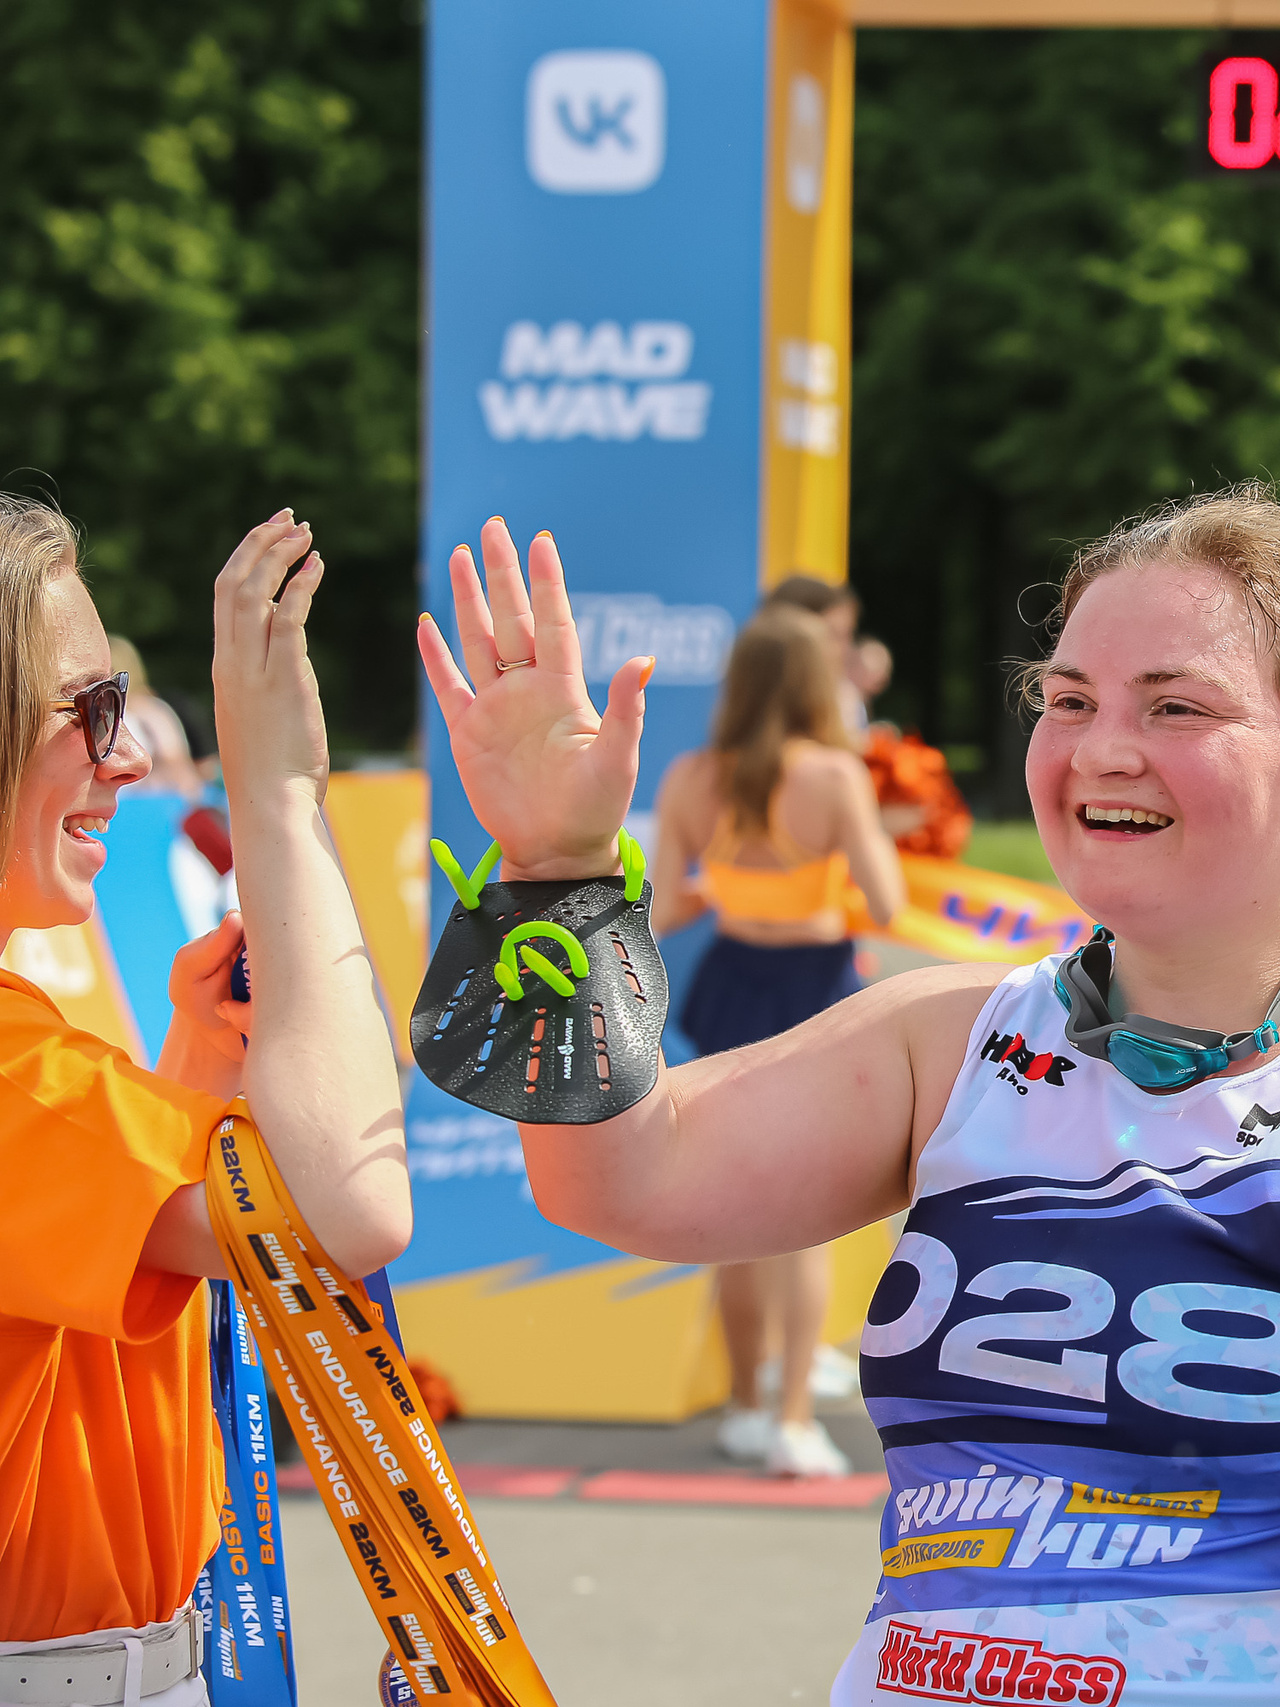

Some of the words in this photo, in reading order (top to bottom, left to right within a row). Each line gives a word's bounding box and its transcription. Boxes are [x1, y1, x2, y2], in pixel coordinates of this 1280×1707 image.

[556, 95, 636, 152] VK
[502, 320, 694, 380] MAD
[479, 380, 713, 442] WAVE
[563, 1056, 572, 1080] MAD
[220, 1135, 256, 1213] 22KM
[365, 1345, 415, 1417] 22KM
[247, 1393, 266, 1464] 11KM
[305, 1330, 408, 1486] ENDURANCE
[398, 1488, 451, 1559] 22KM
[254, 1471, 276, 1565] BASIC
[408, 1418, 488, 1568] ENDURANCE
[349, 1522, 398, 1600] 22KM
[236, 1581, 265, 1647] 11KM
[882, 1628, 976, 1693] World
[975, 1645, 1114, 1700] Class
